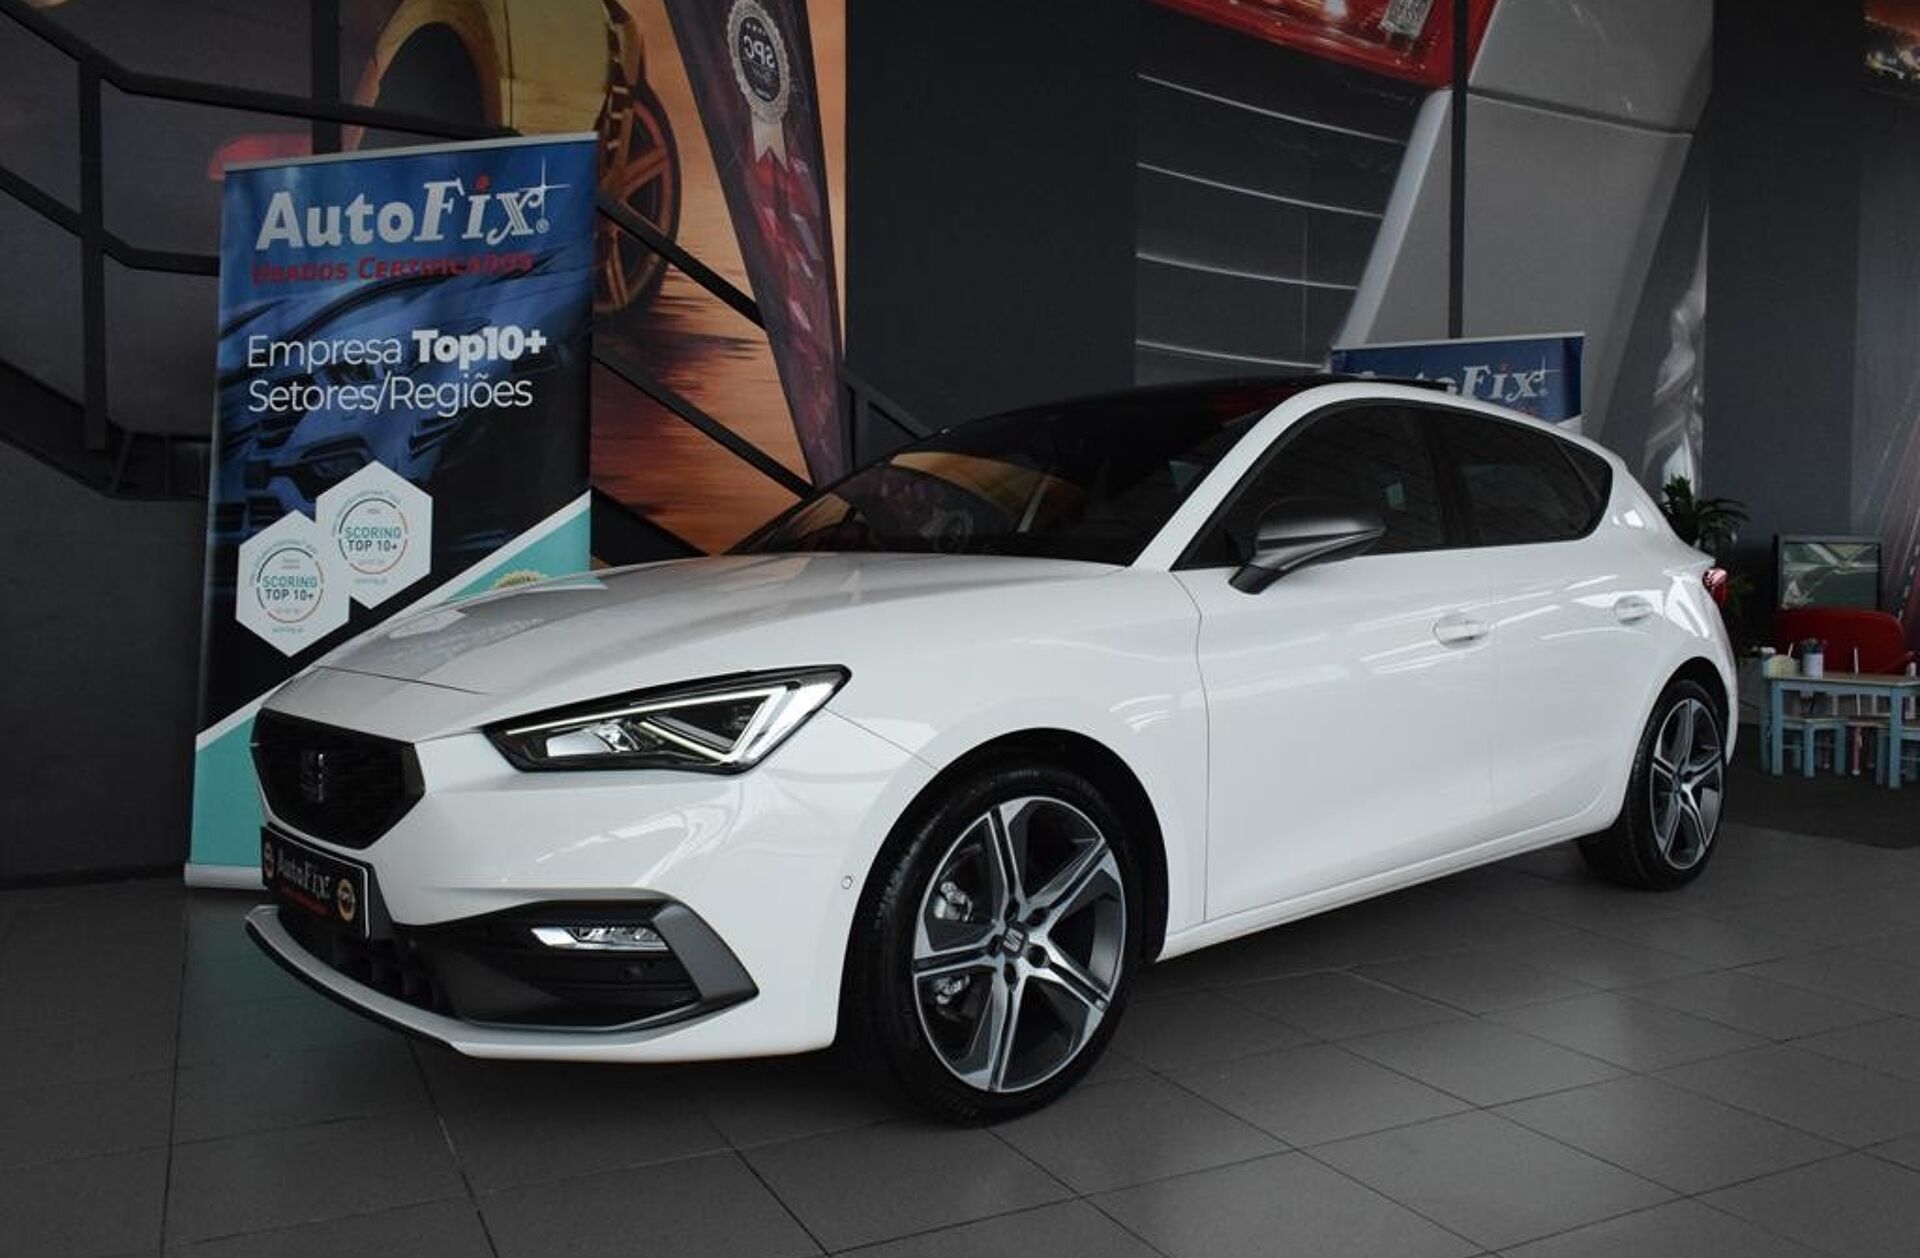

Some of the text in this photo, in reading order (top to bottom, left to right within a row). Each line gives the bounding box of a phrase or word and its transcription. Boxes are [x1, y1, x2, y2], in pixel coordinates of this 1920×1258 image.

[247, 325, 547, 375] Empresa Top10+
[247, 374, 533, 418] Setores/Regiões
[344, 526, 402, 540] SCORING
[347, 539, 398, 552] TOP 10+
[261, 575, 318, 588] SCORING
[265, 588, 290, 600] TOP
